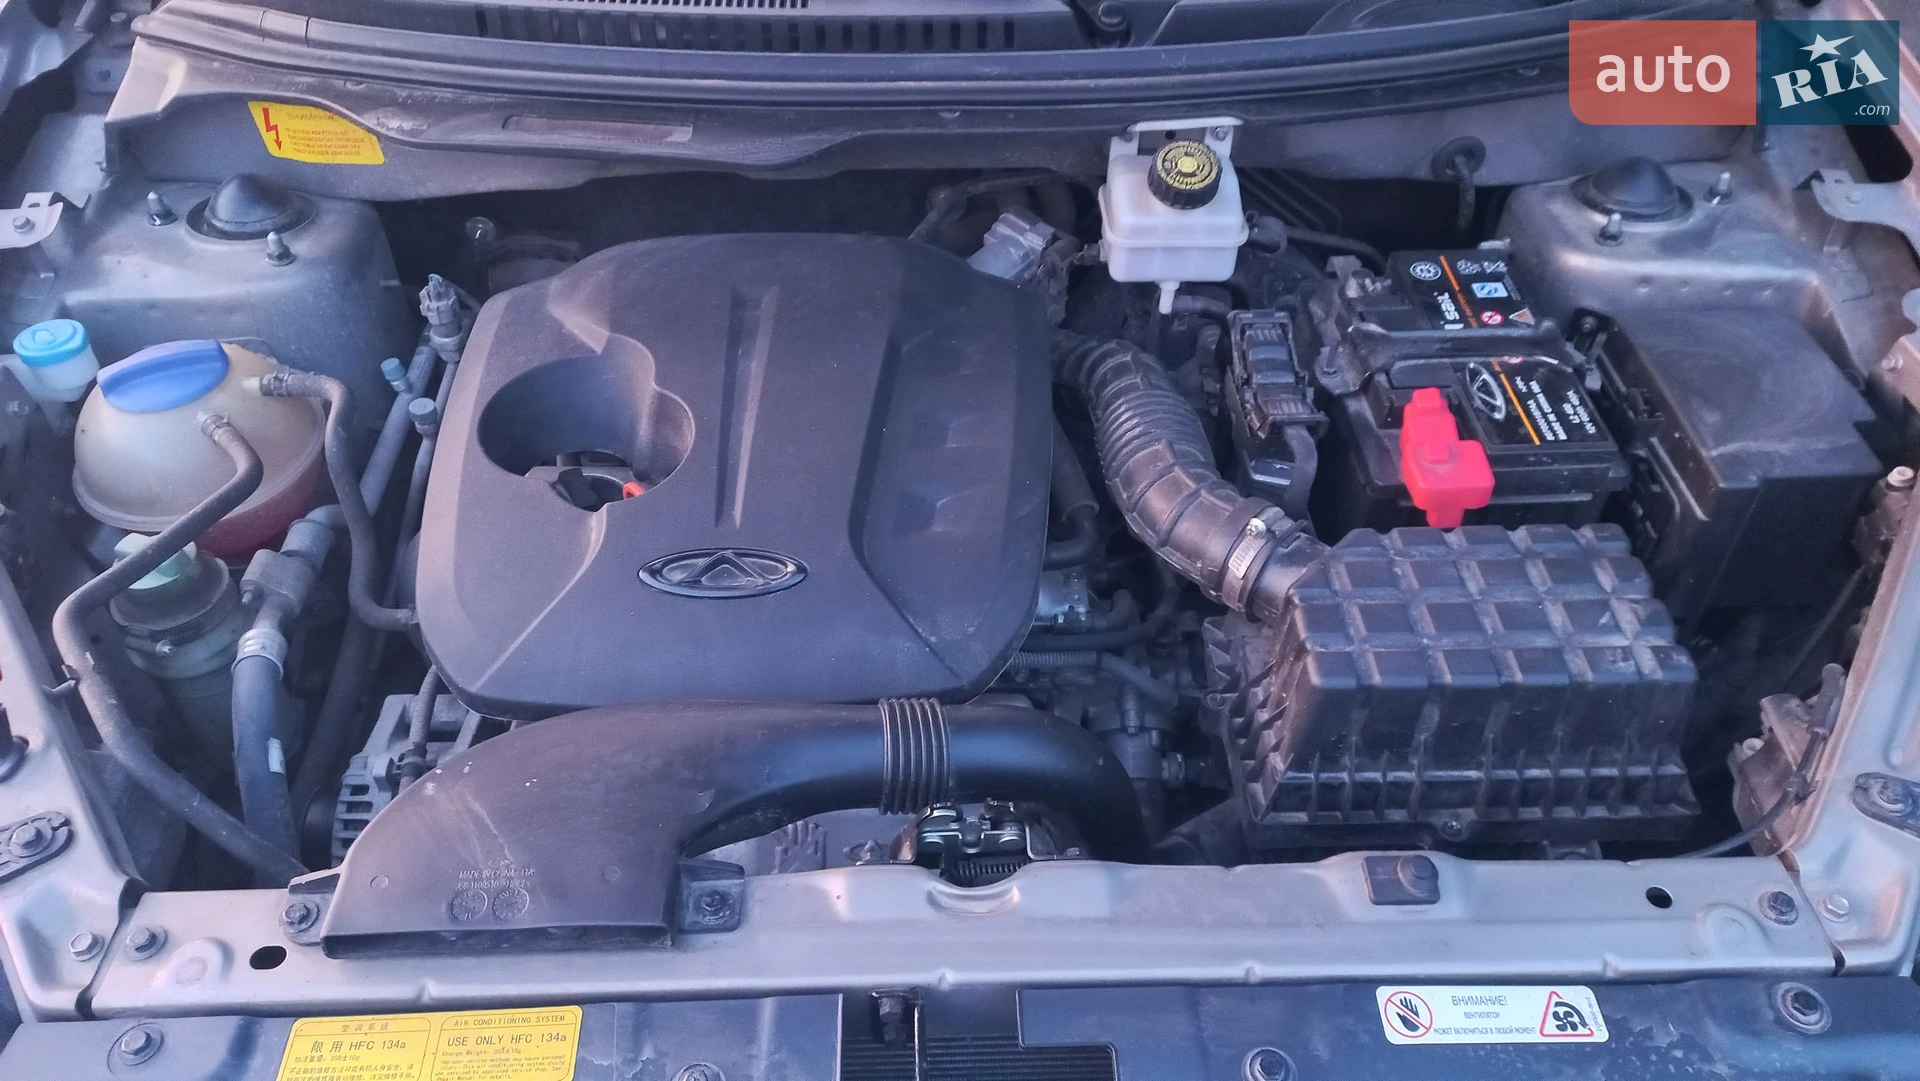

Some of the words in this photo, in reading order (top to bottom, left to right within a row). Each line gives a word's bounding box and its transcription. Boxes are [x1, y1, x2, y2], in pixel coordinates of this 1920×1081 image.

[1451, 995, 1509, 1006] ВНИМАНИЕ!
[473, 1016, 531, 1026] CONDITIONING
[536, 1014, 566, 1023] SYSTEM
[1464, 1011, 1500, 1019] ВЕНТИЛЯТОР
[1433, 1027, 1452, 1035] МОЖЕТ
[1494, 1026, 1514, 1034] ЛЮБОЙ
[1514, 1026, 1536, 1034] МОМЕНТ
[349, 1040, 376, 1051] HFC
[382, 1039, 406, 1050] 134a
[447, 1036, 469, 1047] USE
[475, 1035, 504, 1046] ONLY
[510, 1033, 533, 1044] HFC
[540, 1032, 567, 1042] 134a
